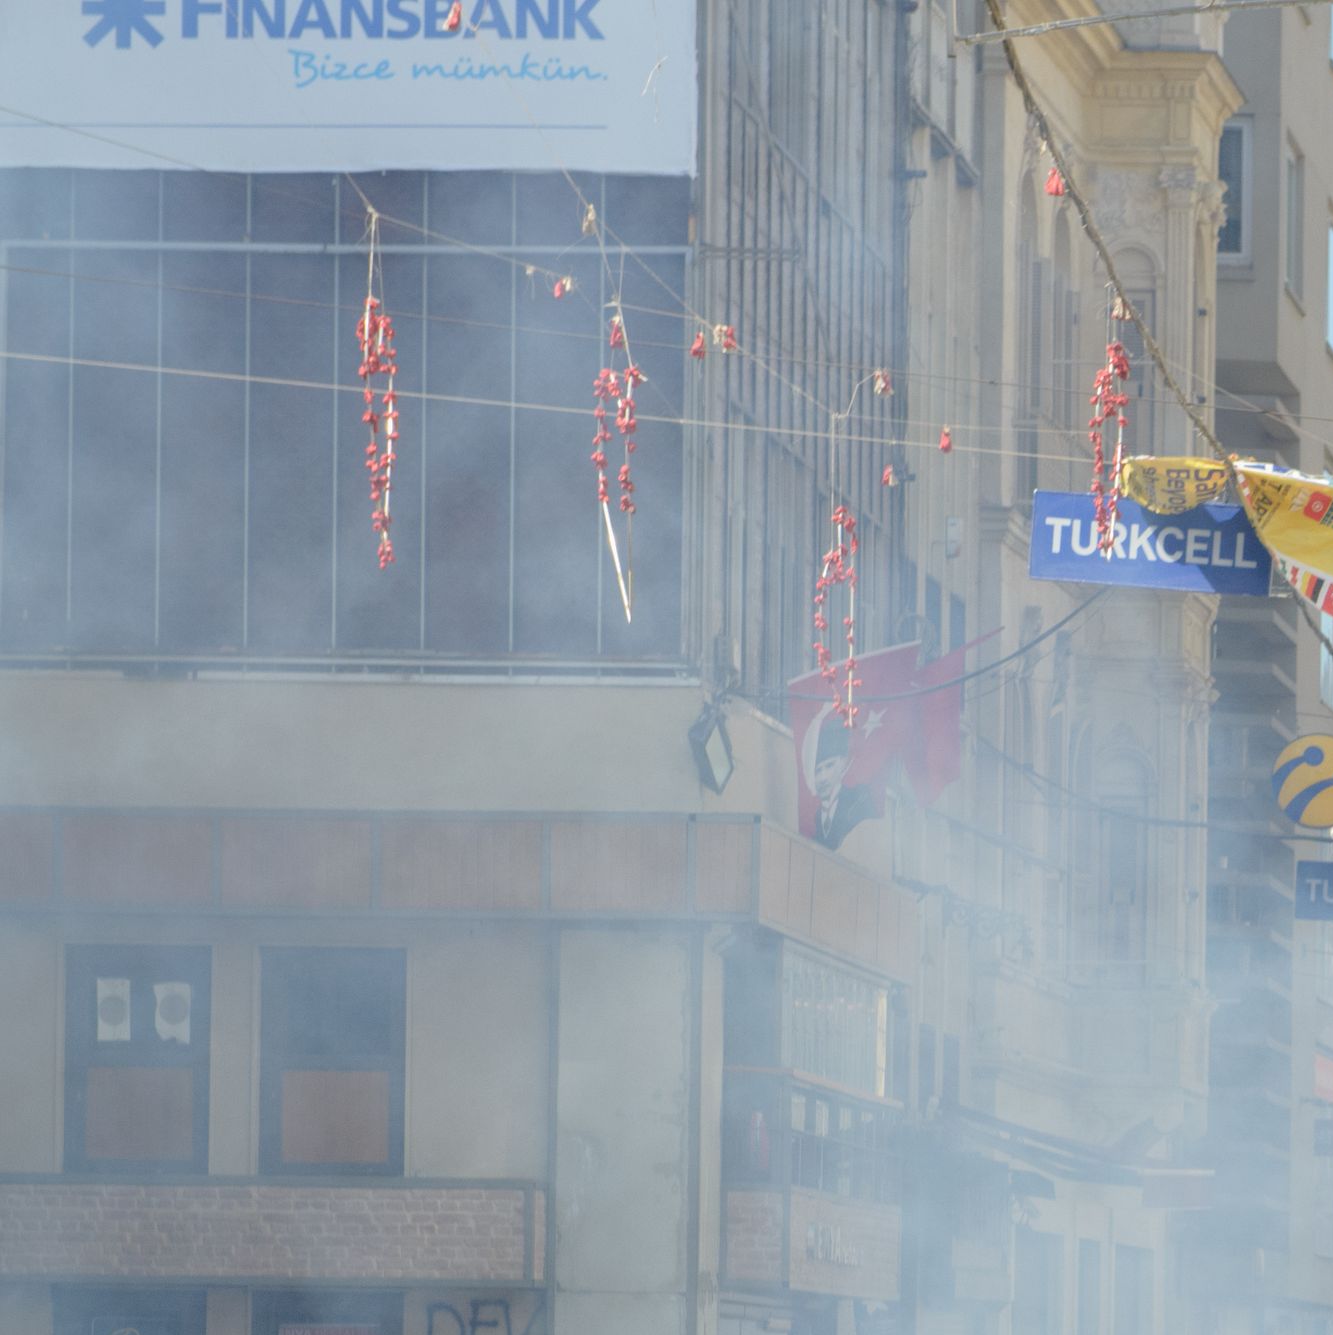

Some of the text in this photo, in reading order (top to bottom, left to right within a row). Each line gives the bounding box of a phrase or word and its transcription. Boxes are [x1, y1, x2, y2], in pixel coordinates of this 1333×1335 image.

[181, 0, 605, 39] FINANSBANK
[288, 49, 609, 87] Bizce mümkün.
[1045, 516, 1258, 569] TURKCELL
